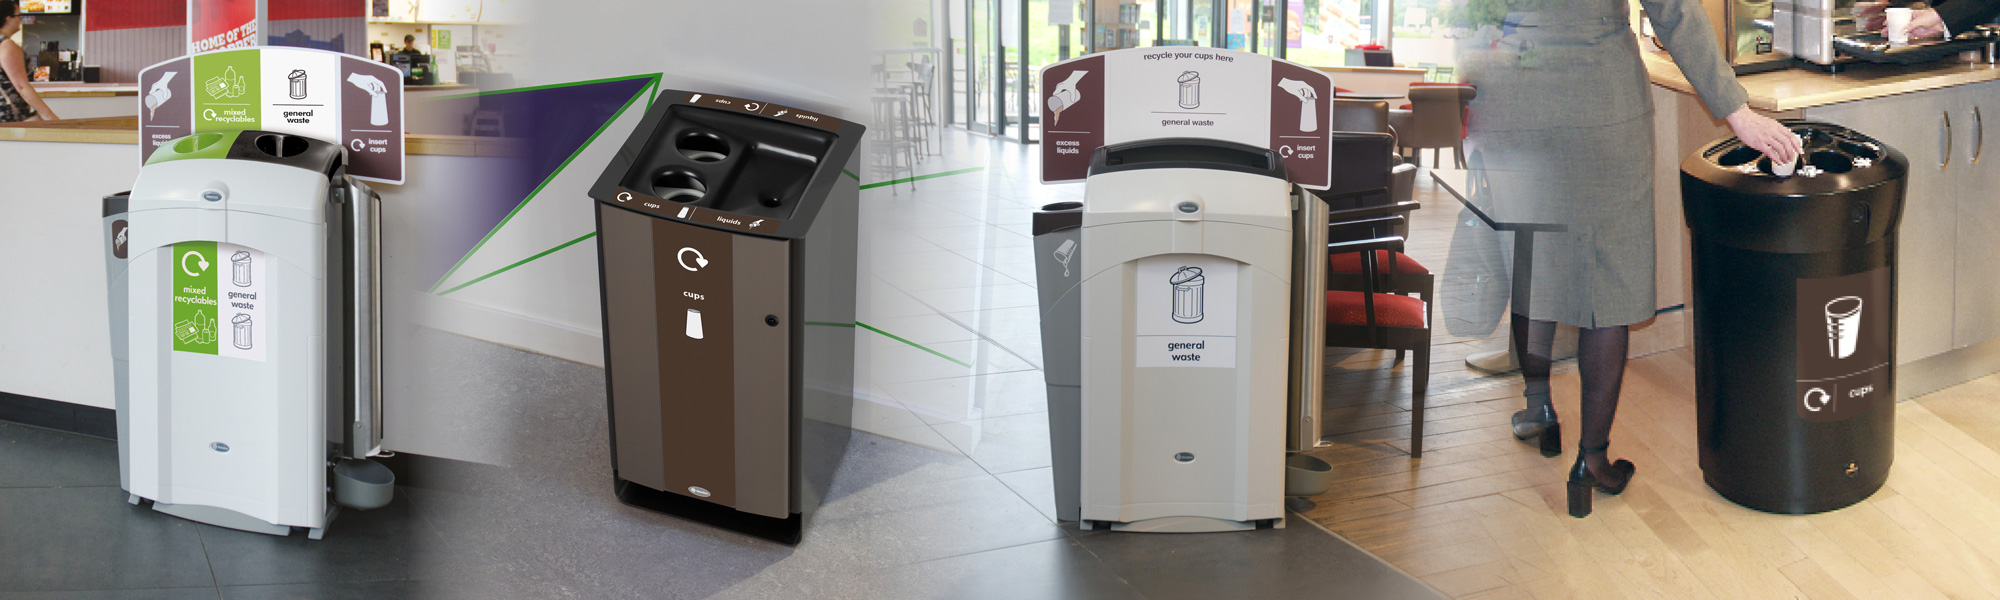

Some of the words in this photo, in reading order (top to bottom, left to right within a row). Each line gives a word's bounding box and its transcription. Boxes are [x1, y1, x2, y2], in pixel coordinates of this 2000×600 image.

[192, 33, 226, 53] HOME
[226, 27, 240, 43] OF
[1143, 51, 1172, 61] recycle
[1174, 52, 1193, 60] your
[1194, 52, 1214, 60] cups
[1215, 53, 1234, 62] here
[224, 108, 246, 116] mixed
[283, 109, 314, 118] general
[215, 115, 255, 124] recyclables
[795, 113, 819, 122] liquids
[1161, 119, 1190, 127] general
[1056, 147, 1080, 155] liquids
[716, 216, 742, 226] liquids
[183, 285, 207, 295] mixed
[228, 291, 257, 300] general
[683, 291, 705, 301] cups
[174, 296, 218, 306] recyclables
[231, 301, 254, 310] waste
[1167, 340, 1205, 352] general
[1171, 353, 1201, 361] waste
[1849, 384, 1874, 398] cups
